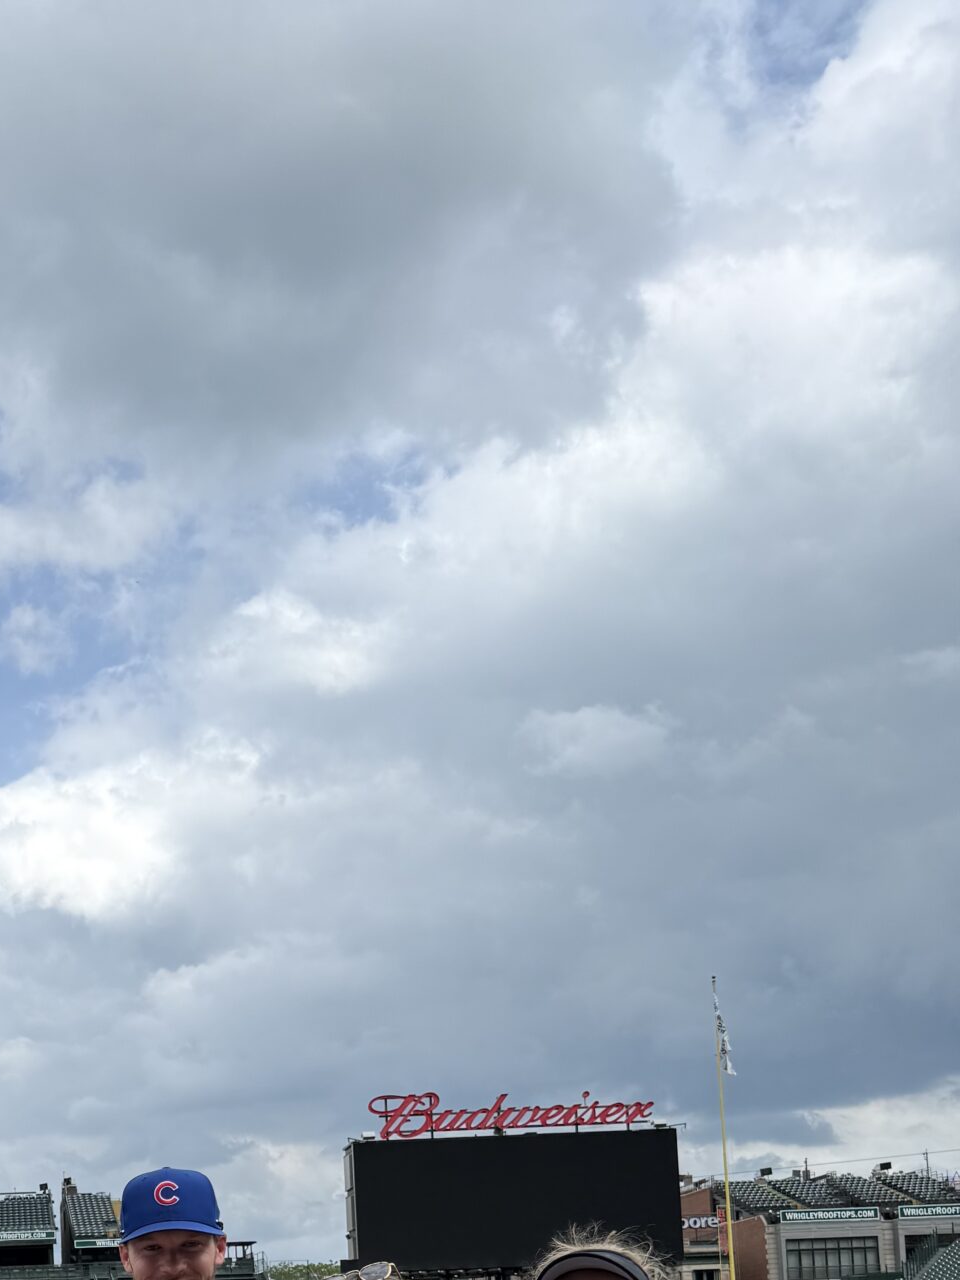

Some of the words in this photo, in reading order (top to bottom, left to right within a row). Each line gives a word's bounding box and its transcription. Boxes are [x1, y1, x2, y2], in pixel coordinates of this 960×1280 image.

[368, 1091, 654, 1139] Budweiser
[153, 1180, 179, 1206] C
[785, 1210, 875, 1220] WRIGLEYROOFTOPS.COM
